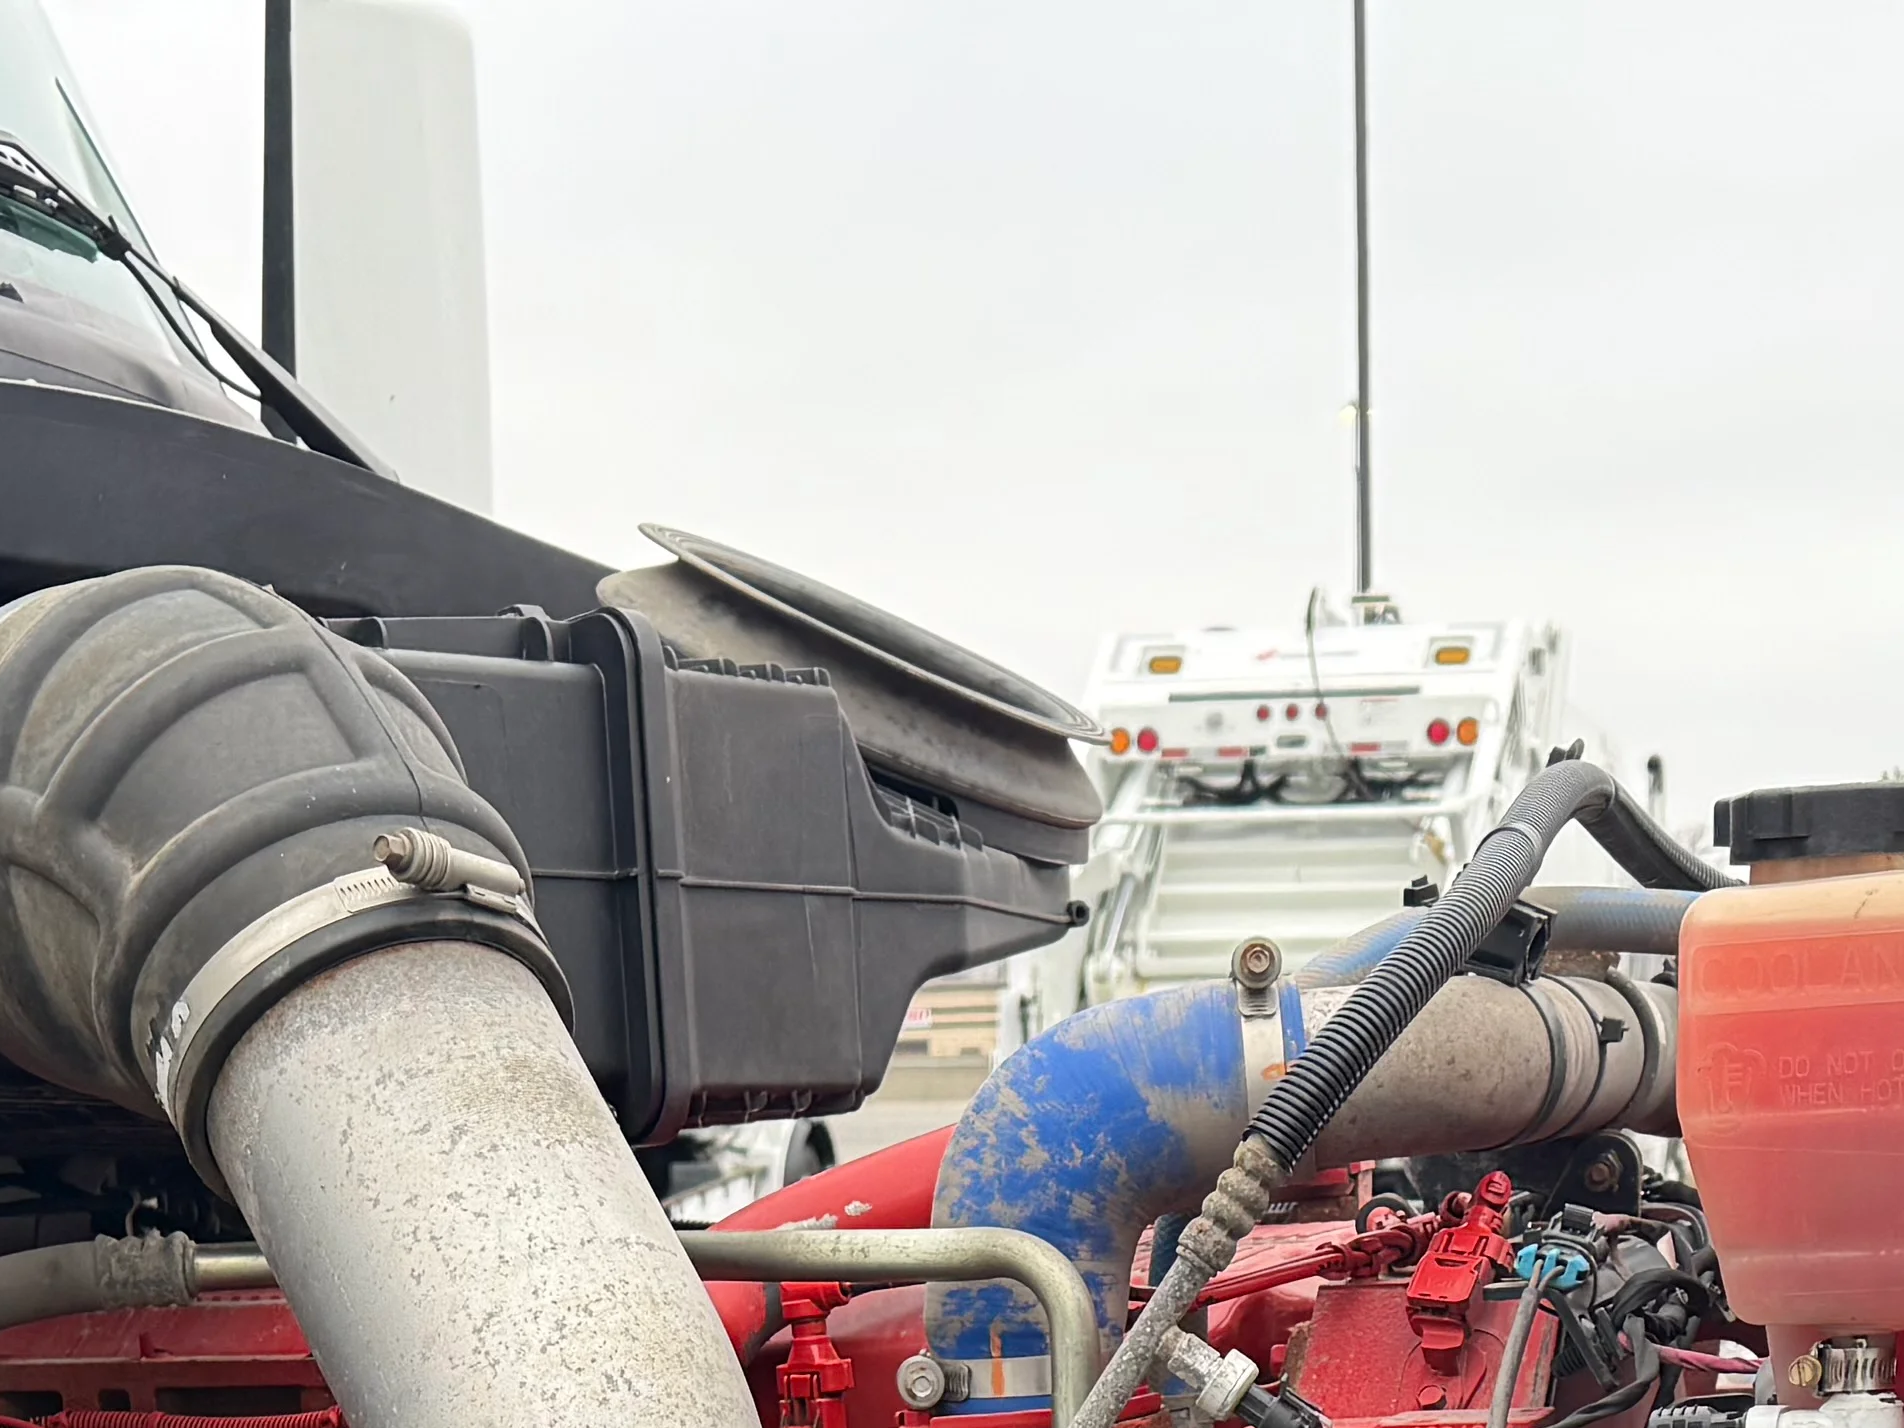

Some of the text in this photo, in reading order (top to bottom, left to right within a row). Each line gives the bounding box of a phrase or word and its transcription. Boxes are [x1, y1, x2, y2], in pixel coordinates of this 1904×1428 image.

[1779, 1056, 1810, 1078] DO
[1826, 1050, 1874, 1076] NOT
[1779, 1082, 1844, 1106] WHEN
